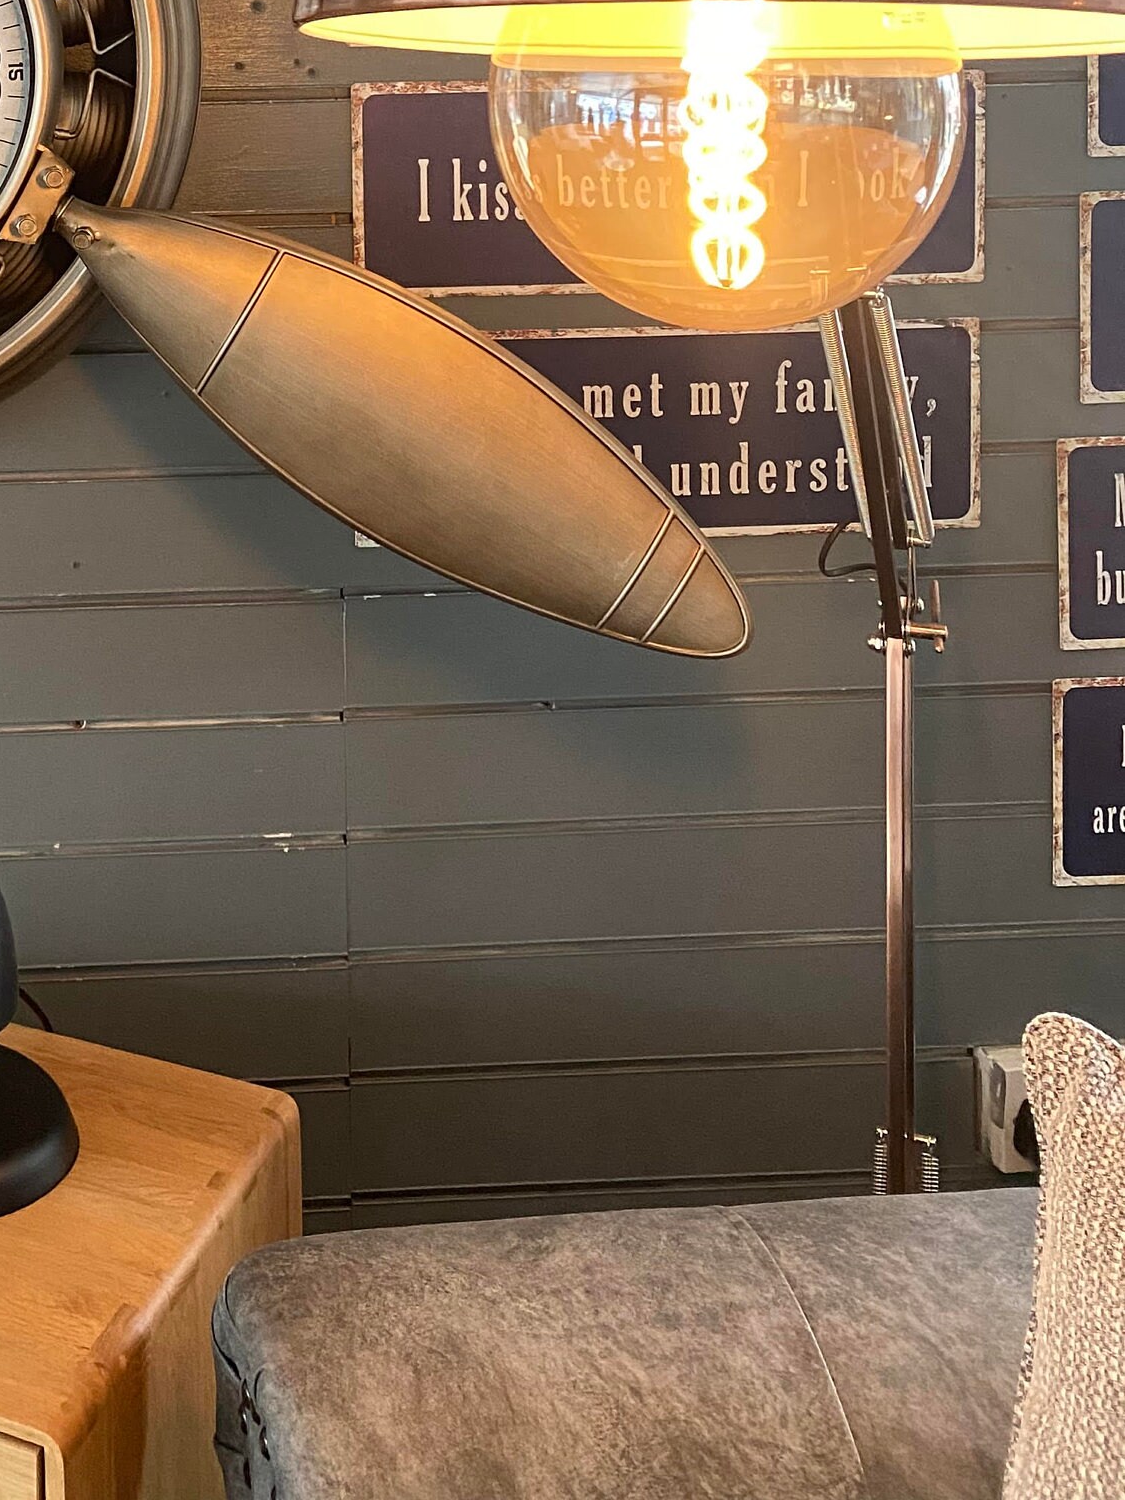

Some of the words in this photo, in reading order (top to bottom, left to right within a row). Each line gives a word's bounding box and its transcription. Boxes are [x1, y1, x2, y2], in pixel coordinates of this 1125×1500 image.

[7, 62, 24, 81] 15
[417, 158, 431, 222] I
[556, 154, 673, 209] better
[796, 150, 809, 208] I
[582, 373, 664, 419] met
[689, 381, 750, 425] my
[670, 436, 933, 496] understd
